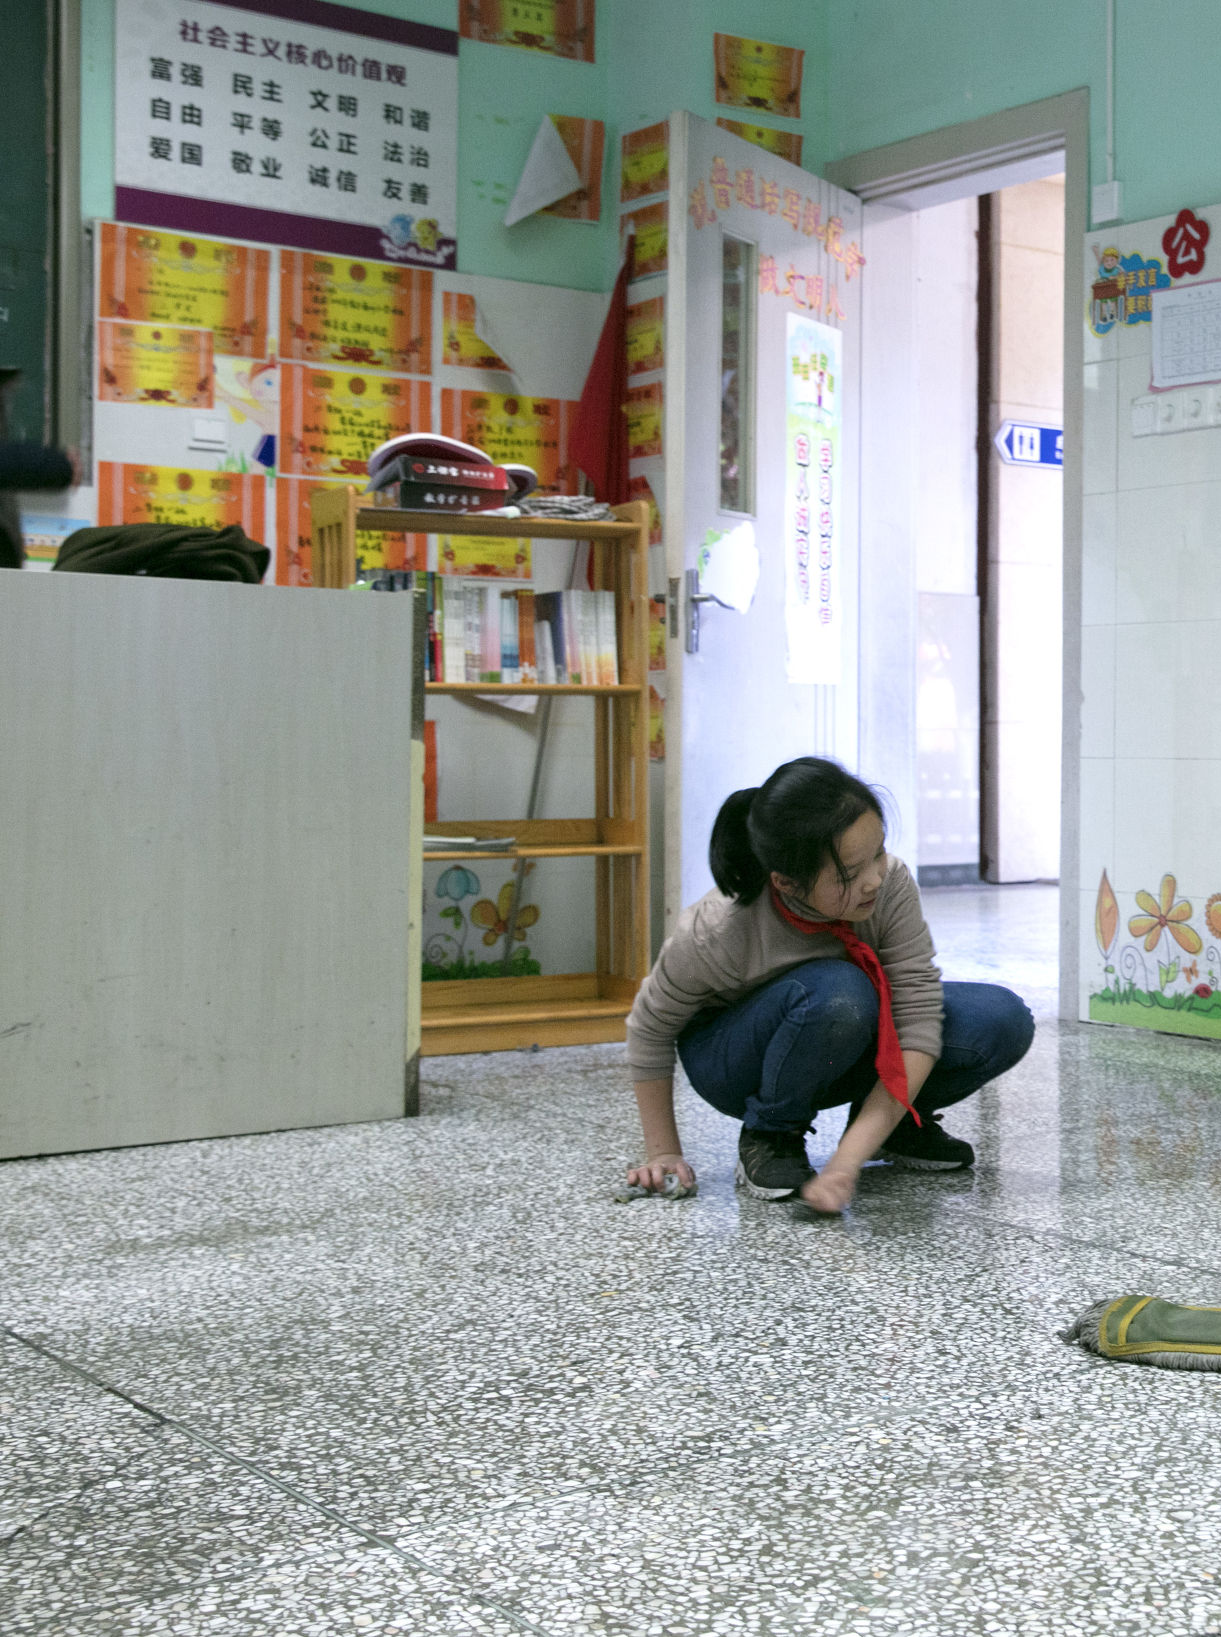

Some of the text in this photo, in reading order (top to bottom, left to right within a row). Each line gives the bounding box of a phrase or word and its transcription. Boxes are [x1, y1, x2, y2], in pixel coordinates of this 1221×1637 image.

[178, 19, 407, 87] 社会主义核心价值观
[149, 57, 431, 133] 富强 民主 文明 和谐
[150, 98, 430, 169] 自由 平等 公正 法治
[149, 136, 429, 206] 爱国 敬业 诚信 友善
